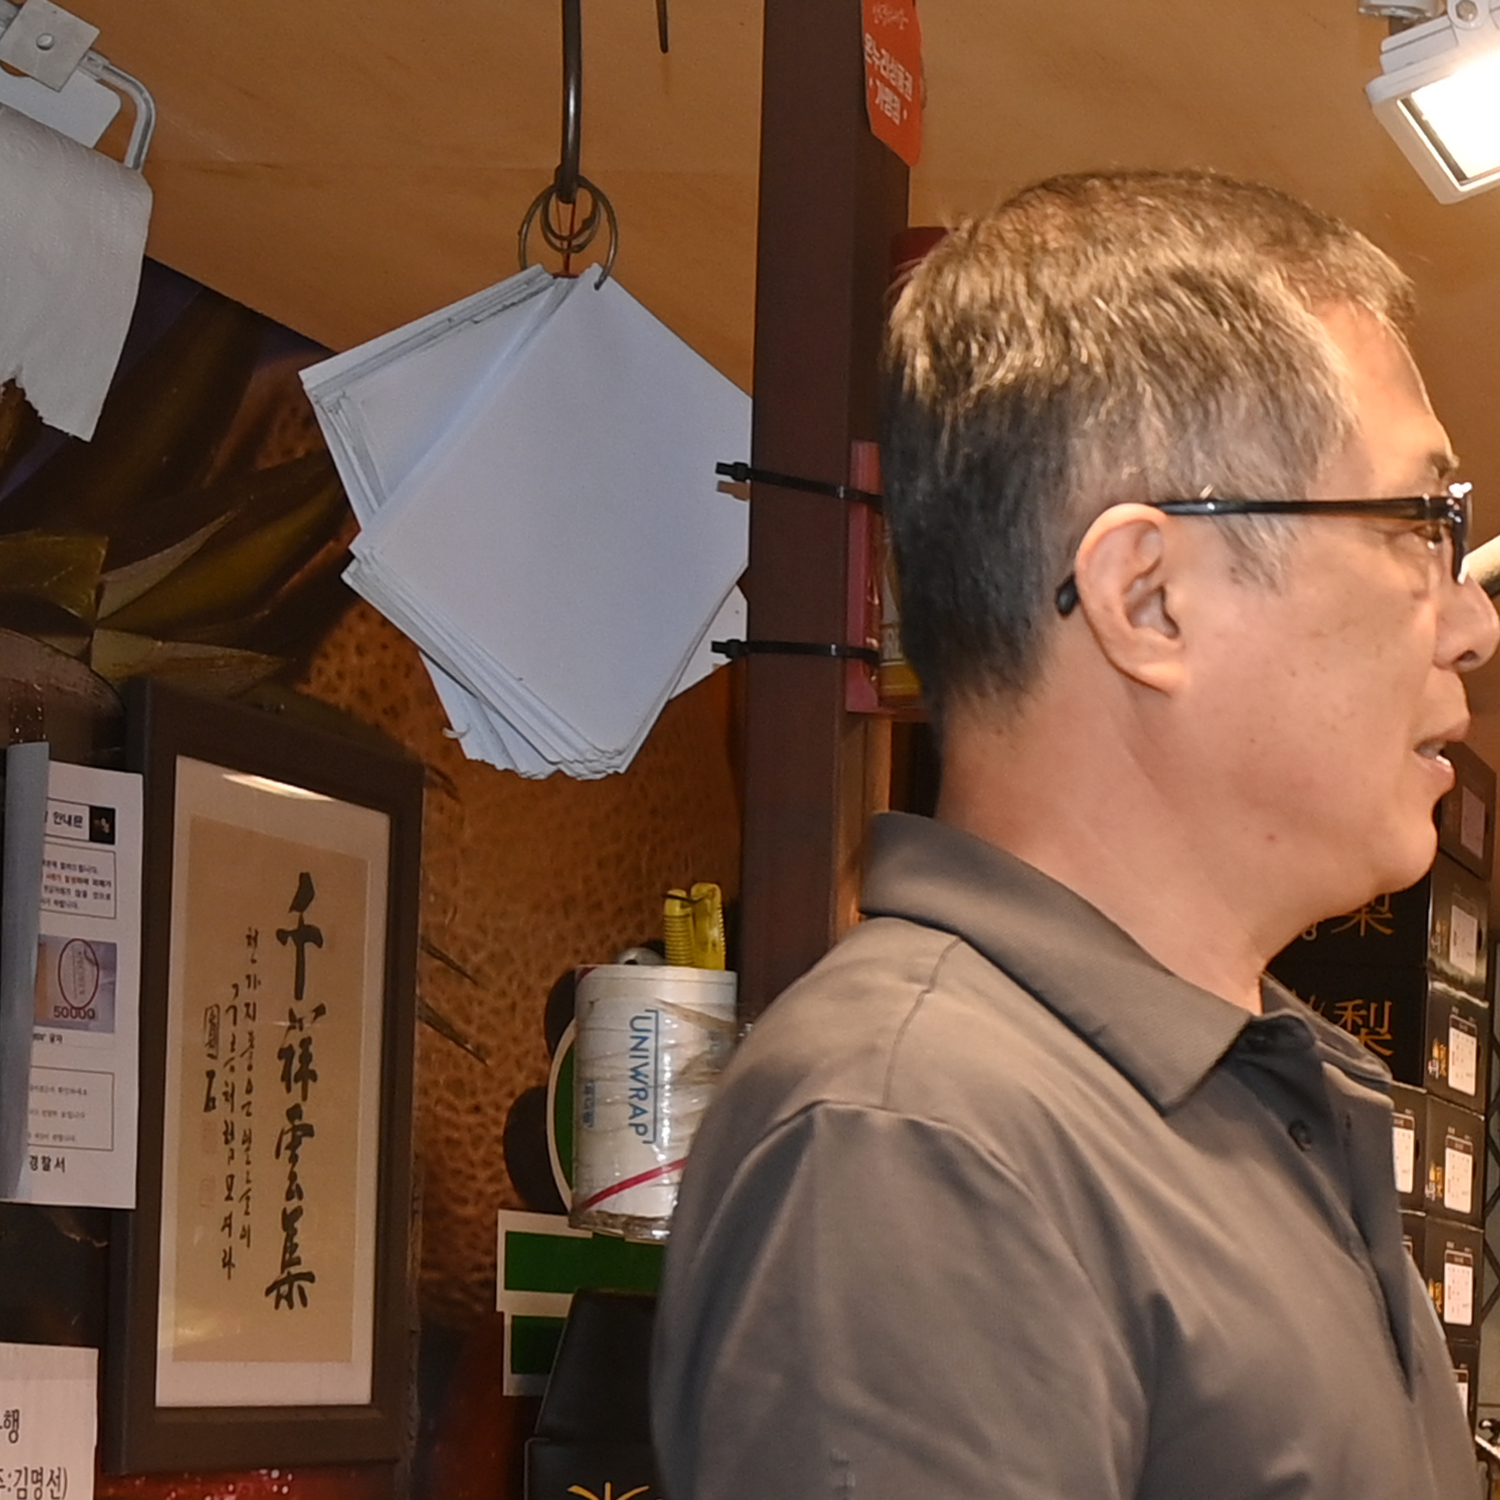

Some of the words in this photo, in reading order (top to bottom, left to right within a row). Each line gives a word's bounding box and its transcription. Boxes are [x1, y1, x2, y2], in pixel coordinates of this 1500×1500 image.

[54, 1005, 96, 1021] 50000
[628, 1015, 650, 1138] UNIWRAP
[29, 1155, 66, 1173] 경찰서
